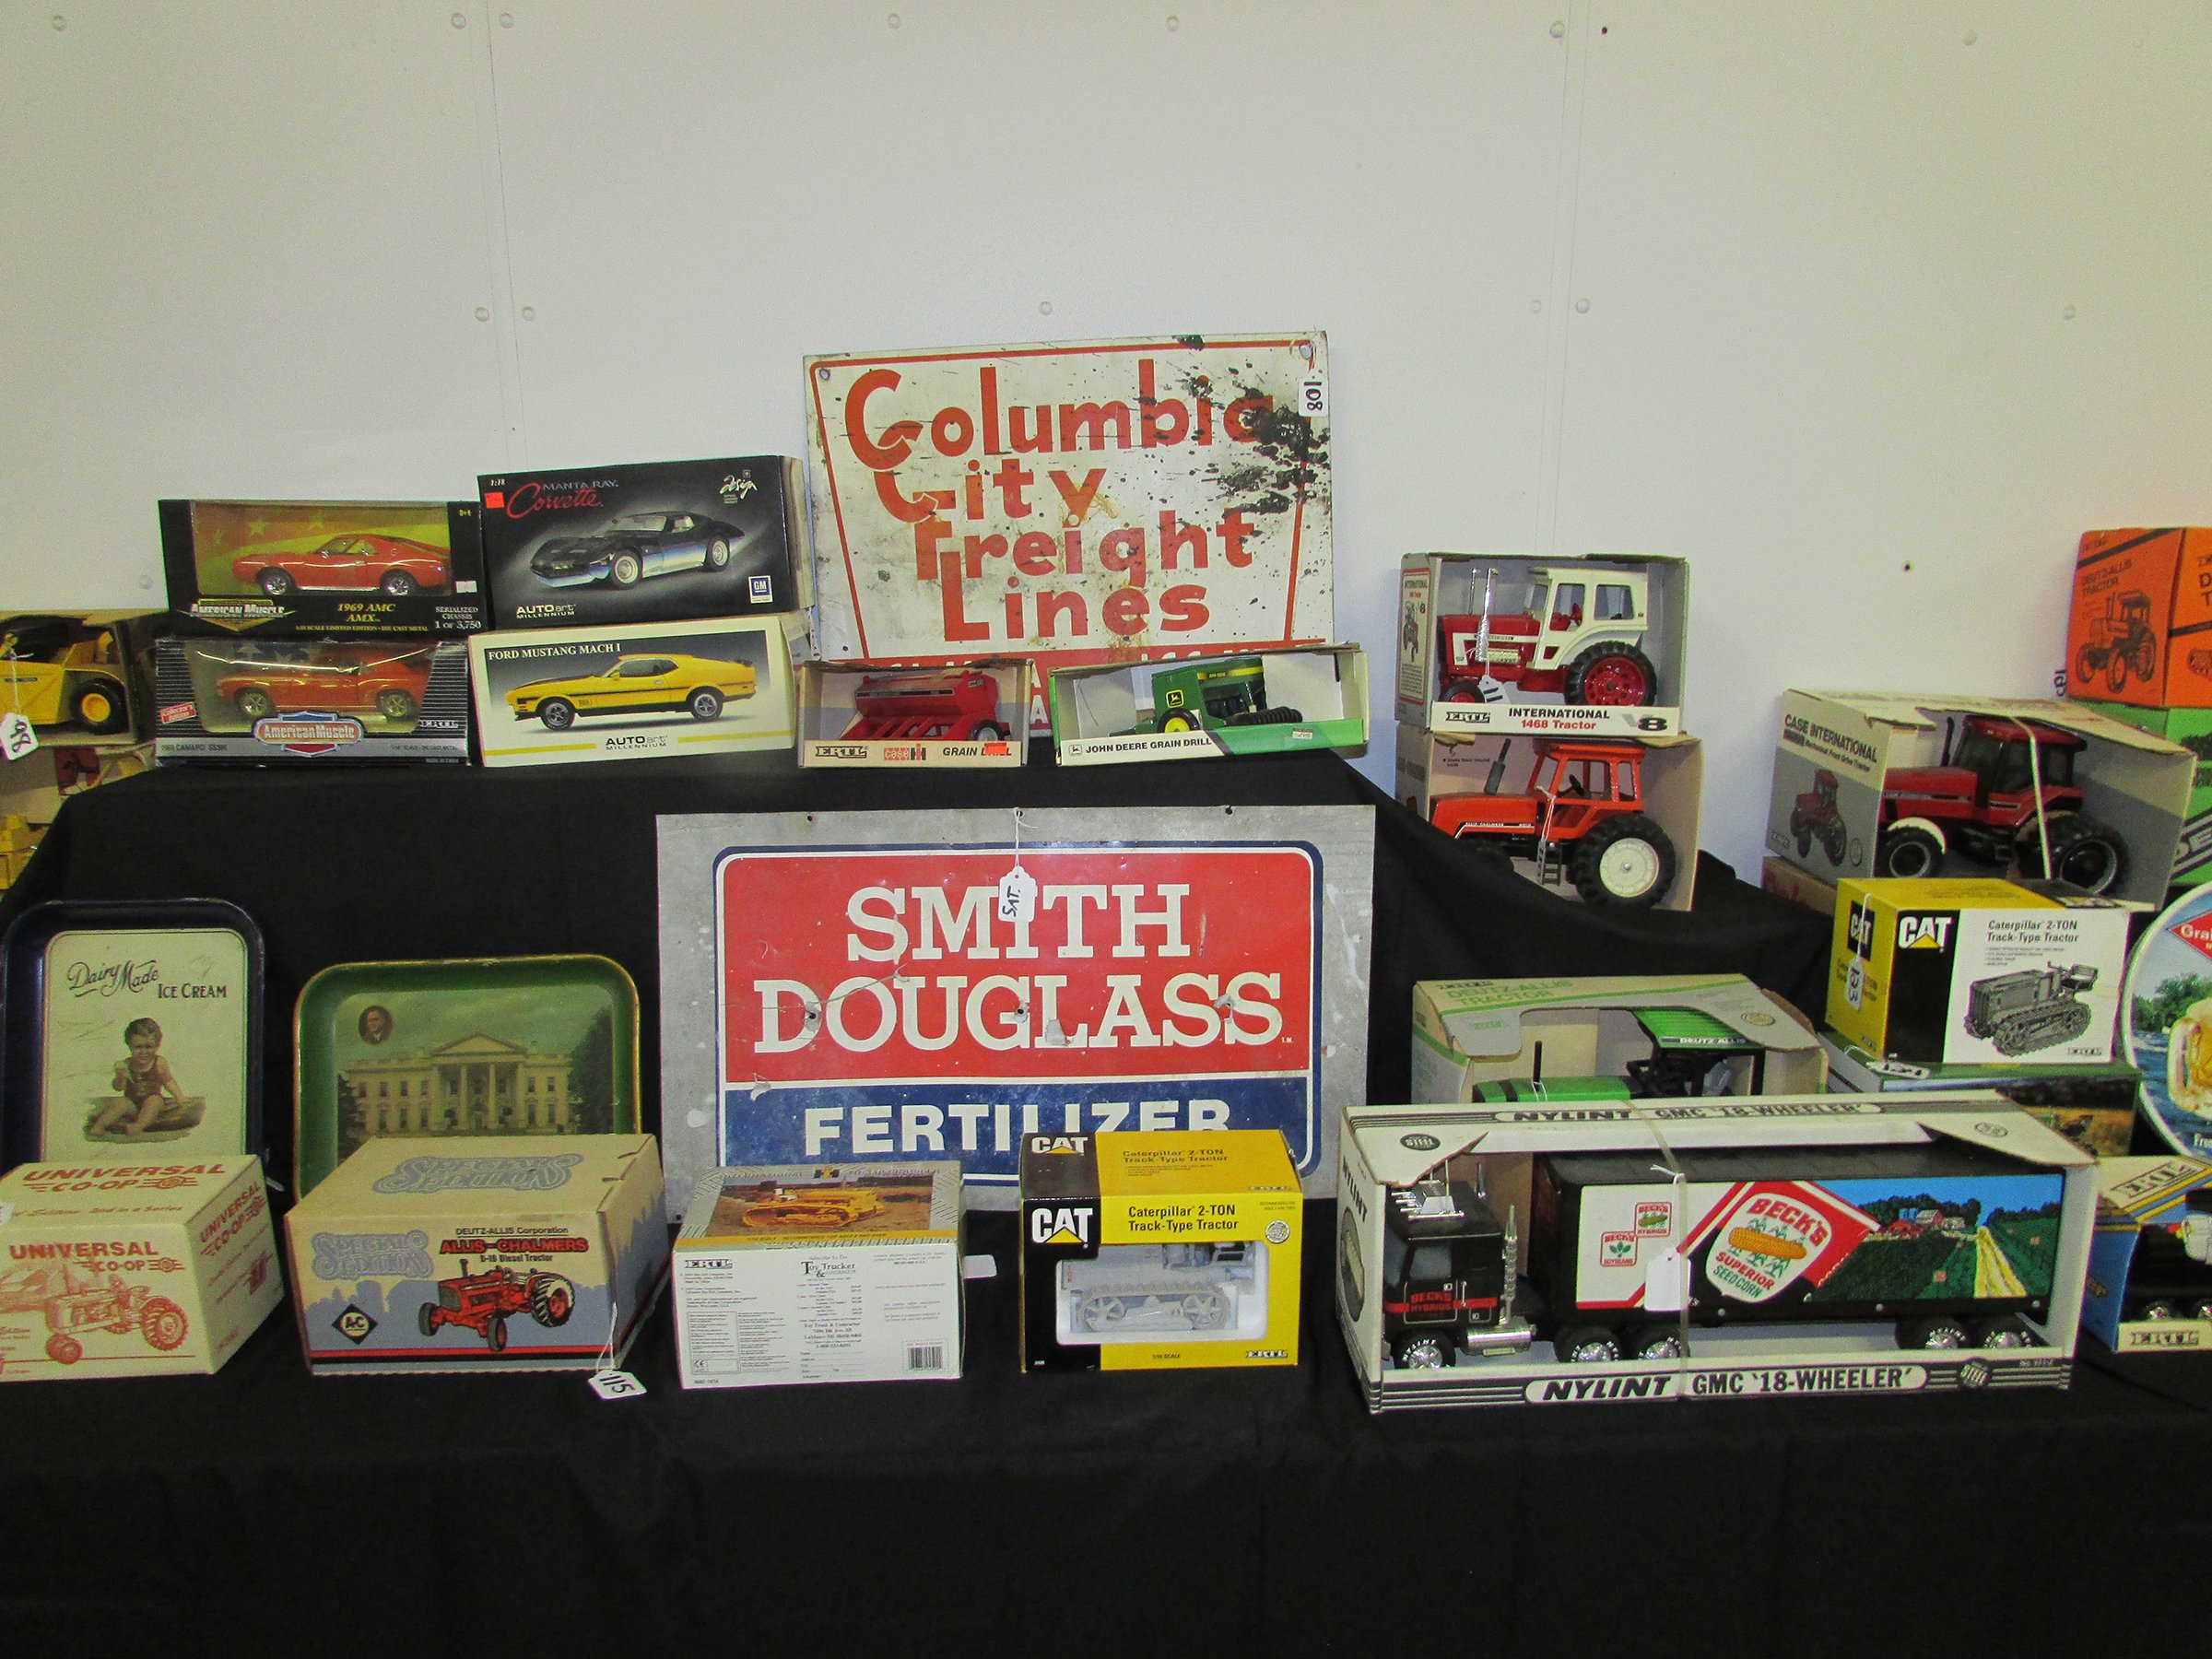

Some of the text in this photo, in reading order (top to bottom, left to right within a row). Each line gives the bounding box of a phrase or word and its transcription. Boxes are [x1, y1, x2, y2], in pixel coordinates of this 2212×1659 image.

[1306, 382, 1324, 411] 108
[845, 359, 1276, 470] Columbia
[490, 478, 506, 487] 1:18
[542, 481, 590, 491] MANTA
[873, 459, 1108, 526] City
[507, 483, 601, 519] Corvette
[913, 489, 1254, 588] Freight
[754, 581, 768, 591] GM
[940, 552, 1210, 642] Lines
[190, 604, 285, 617] AMERICAN MUSCLE
[337, 604, 396, 612] 1969 AMC
[516, 610, 575, 620] MILLENNIUM
[456, 621, 482, 629] 3,750
[488, 650, 520, 660] FORD
[522, 647, 577, 659] MUSTANG
[579, 643, 615, 655] MACH
[1445, 711, 1490, 724] ERTL
[1508, 708, 1610, 720] INTERNATIONAL
[419, 720, 459, 728] ERTL
[1521, 719, 1596, 730] 1468 Tractor
[1086, 737, 1212, 755] JOHN DEERE GRAIN DRILL
[1784, 713, 1809, 735] CASE
[1809, 723, 1877, 764] INTERNATIONAL
[606, 742, 666, 751] MILLENNIUM
[815, 746, 868, 759] ERTL
[943, 747, 977, 757] GRAIN
[846, 883, 1192, 963] SMITH
[1851, 912, 1872, 946] CAT
[1988, 920, 2078, 931] Caterpillar 2-TON
[1899, 916, 1953, 949] CAT
[1987, 932, 2079, 944] Track-Type Tractor
[67, 959, 159, 995] Dairy Made
[158, 982, 228, 999] ICE CREAM
[753, 971, 1282, 1053] DOUGLASS
[1514, 1109, 1633, 1121] NYLINT
[1654, 1107, 1708, 1120] GMC
[1031, 1135, 1088, 1154] CAT
[1405, 1137, 1434, 1147] STEEL
[1123, 1149, 1182, 1158] Caterpillar
[23, 1163, 226, 1182] UNIVERSAL
[199, 1181, 262, 1243] UNIVERSAL
[1128, 1204, 1236, 1219] Caterpillar 2-TON
[1031, 1207, 1094, 1243] CAT
[1128, 1218, 1238, 1233] Track-Type Tractor
[1747, 1198, 1828, 1247] BECK'S
[456, 1226, 569, 1236] DEUTZ-ALLIS Corporation
[10, 1241, 159, 1260] UNIVERSAL
[440, 1237, 590, 1254] ALLIS-CHALMERS
[500, 1254, 524, 1263] Diesel
[525, 1253, 553, 1263] Tractor
[685, 1258, 734, 1269] ERTL
[801, 1261, 856, 1275] Toy Trucker
[1715, 1252, 1775, 1291] SUPERIOR
[1246, 1349, 1289, 1359] ERTL
[598, 1373, 638, 1394] 115
[1542, 1376, 1672, 1401] NYLINT
[1693, 1372, 1745, 1394] GMC
